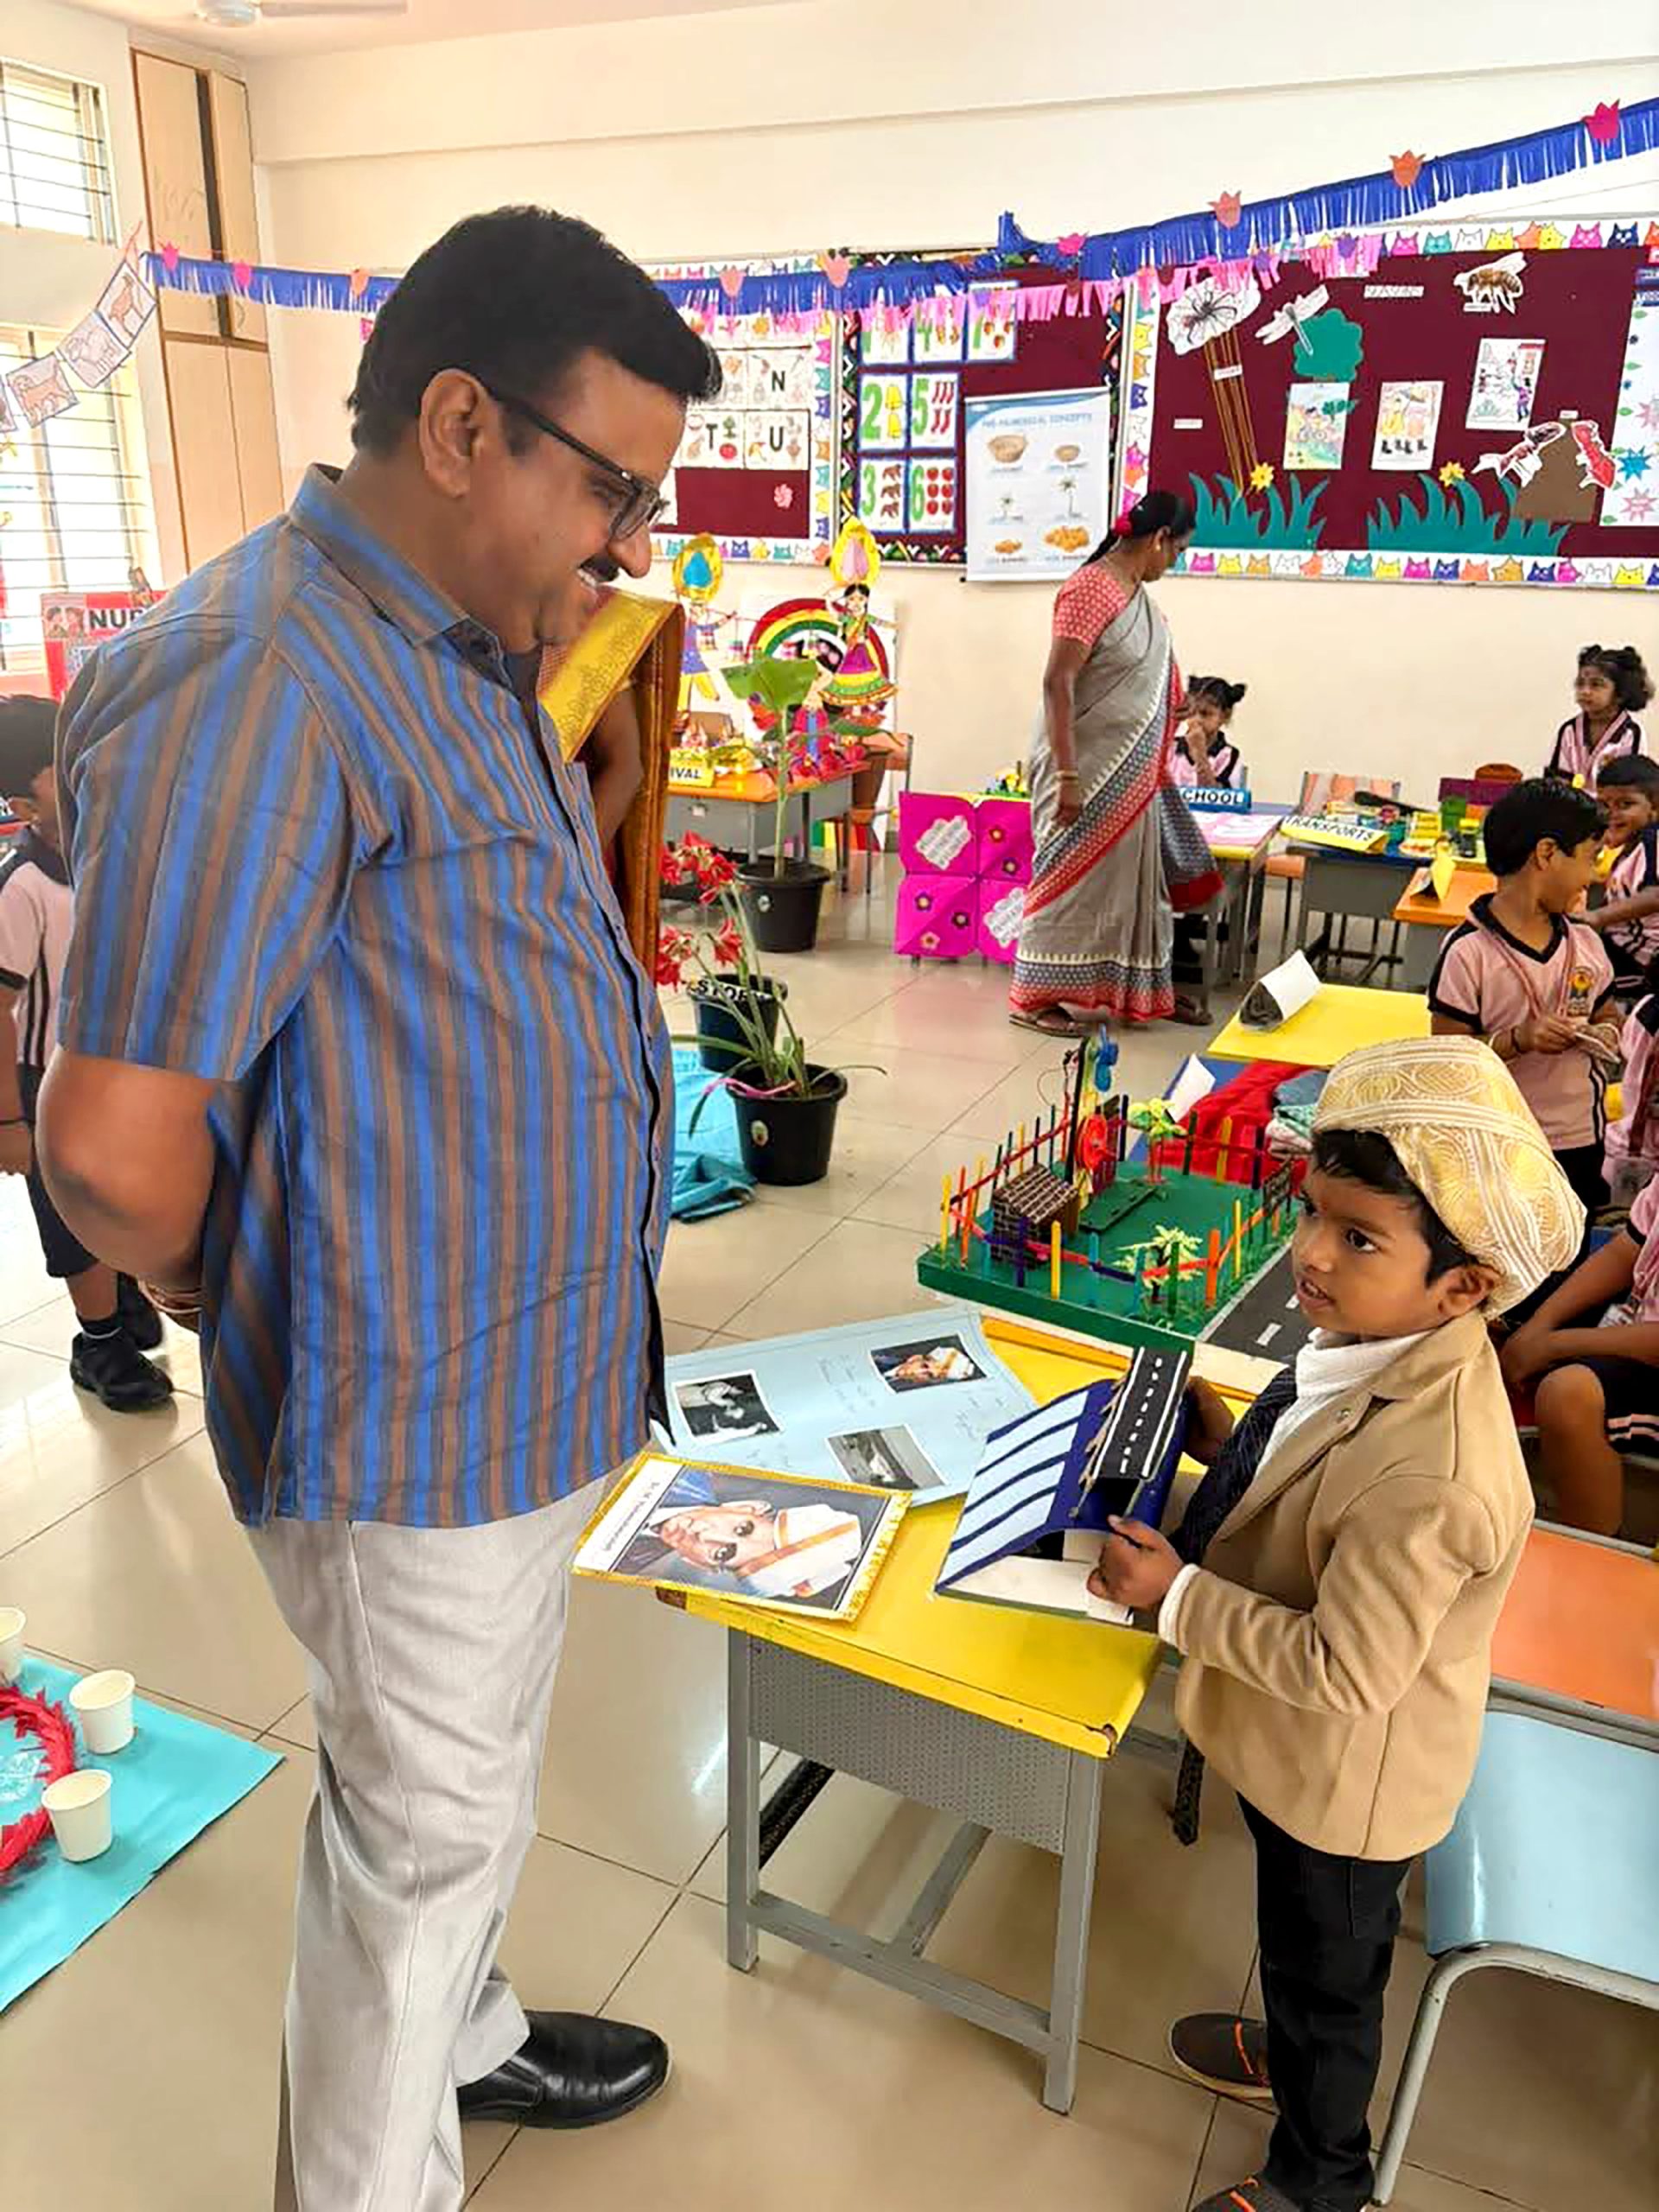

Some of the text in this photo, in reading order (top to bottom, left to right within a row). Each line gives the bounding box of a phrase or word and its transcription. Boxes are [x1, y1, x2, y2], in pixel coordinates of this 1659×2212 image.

[772, 371, 785, 391] N
[861, 383, 882, 440] 2
[912, 378, 929, 436] 5
[705, 423, 718, 449] T
[769, 426, 784, 452] U
[861, 463, 876, 516] 3
[912, 464, 925, 521] 6
[1283, 816, 1375, 842] TRANSPORTS
